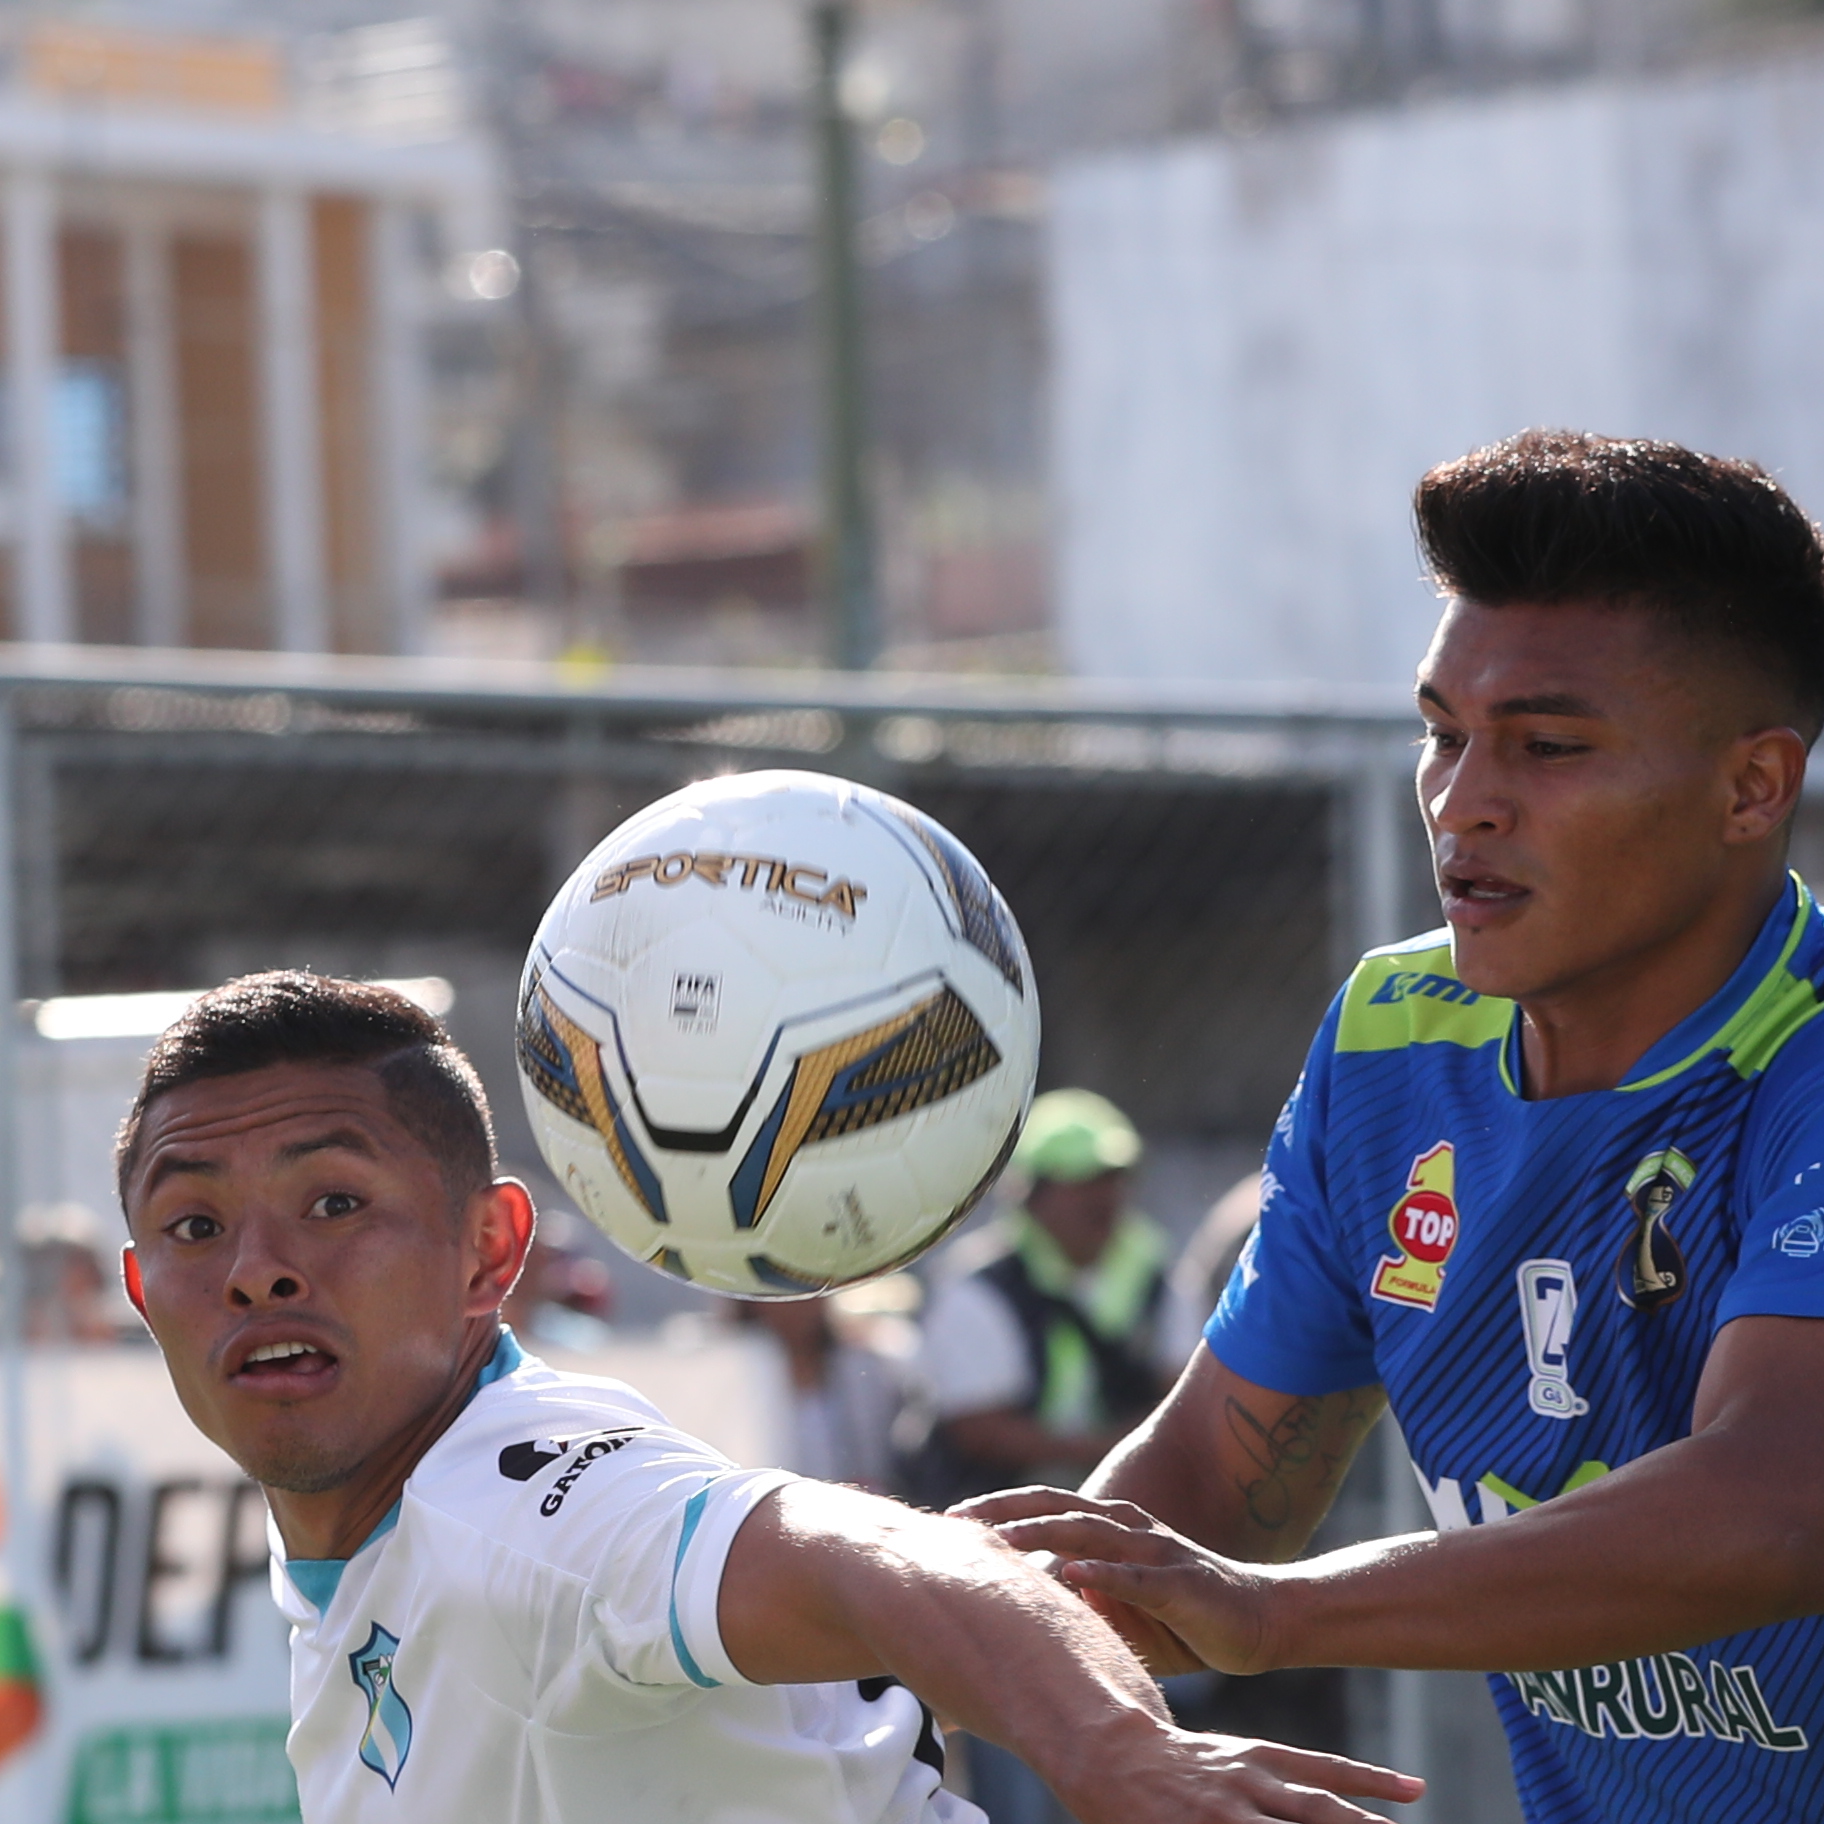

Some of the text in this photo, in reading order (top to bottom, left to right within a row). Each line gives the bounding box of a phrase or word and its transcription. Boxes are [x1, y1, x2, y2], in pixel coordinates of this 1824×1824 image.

[590, 852, 858, 921] SPORTICA
[677, 974, 715, 997] FIFA
[1404, 1206, 1455, 1248] TOP
[1508, 1652, 1809, 1751] ANRURAL
